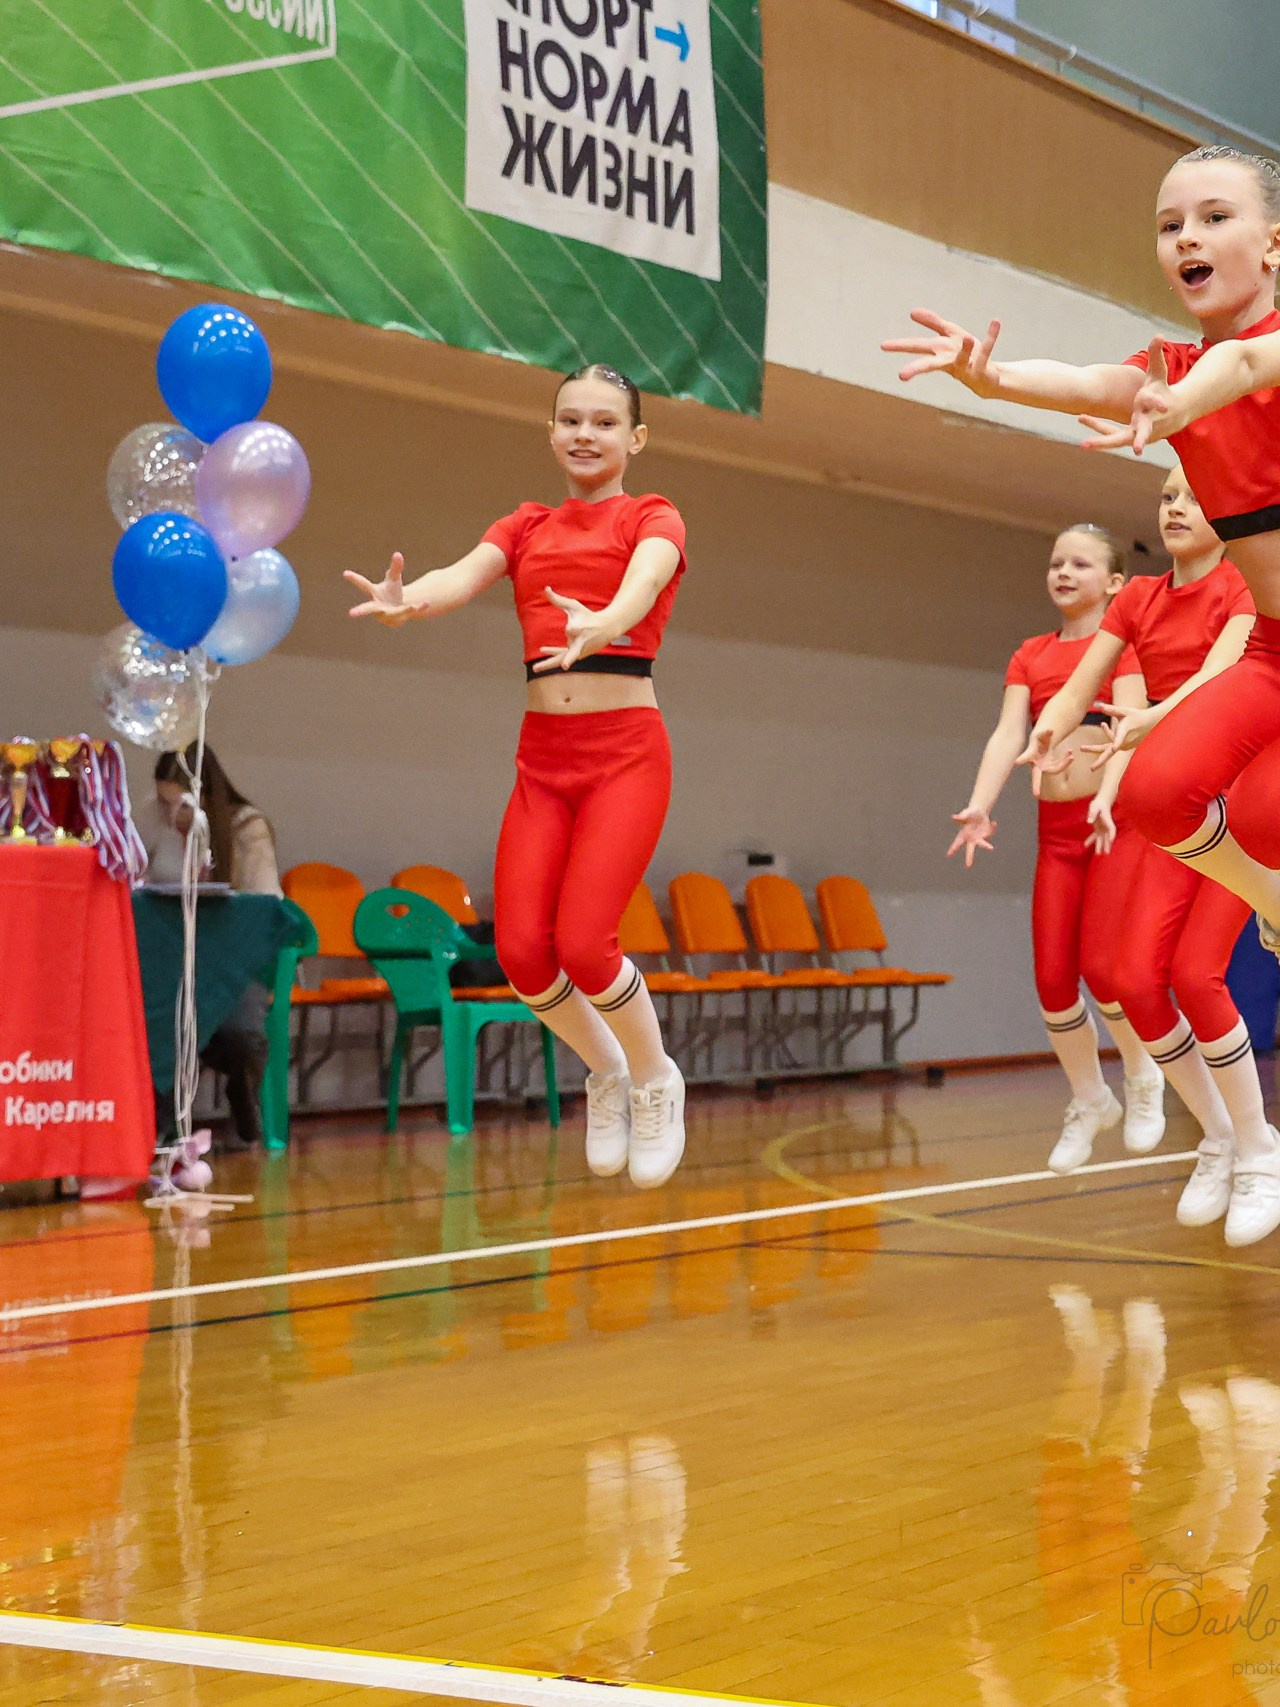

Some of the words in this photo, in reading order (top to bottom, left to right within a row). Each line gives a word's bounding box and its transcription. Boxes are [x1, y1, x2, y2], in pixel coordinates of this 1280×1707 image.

[498, 18, 693, 156] НОРМА
[501, 103, 695, 235] ЖИЗНИ
[5, 1095, 116, 1131] Карелия
